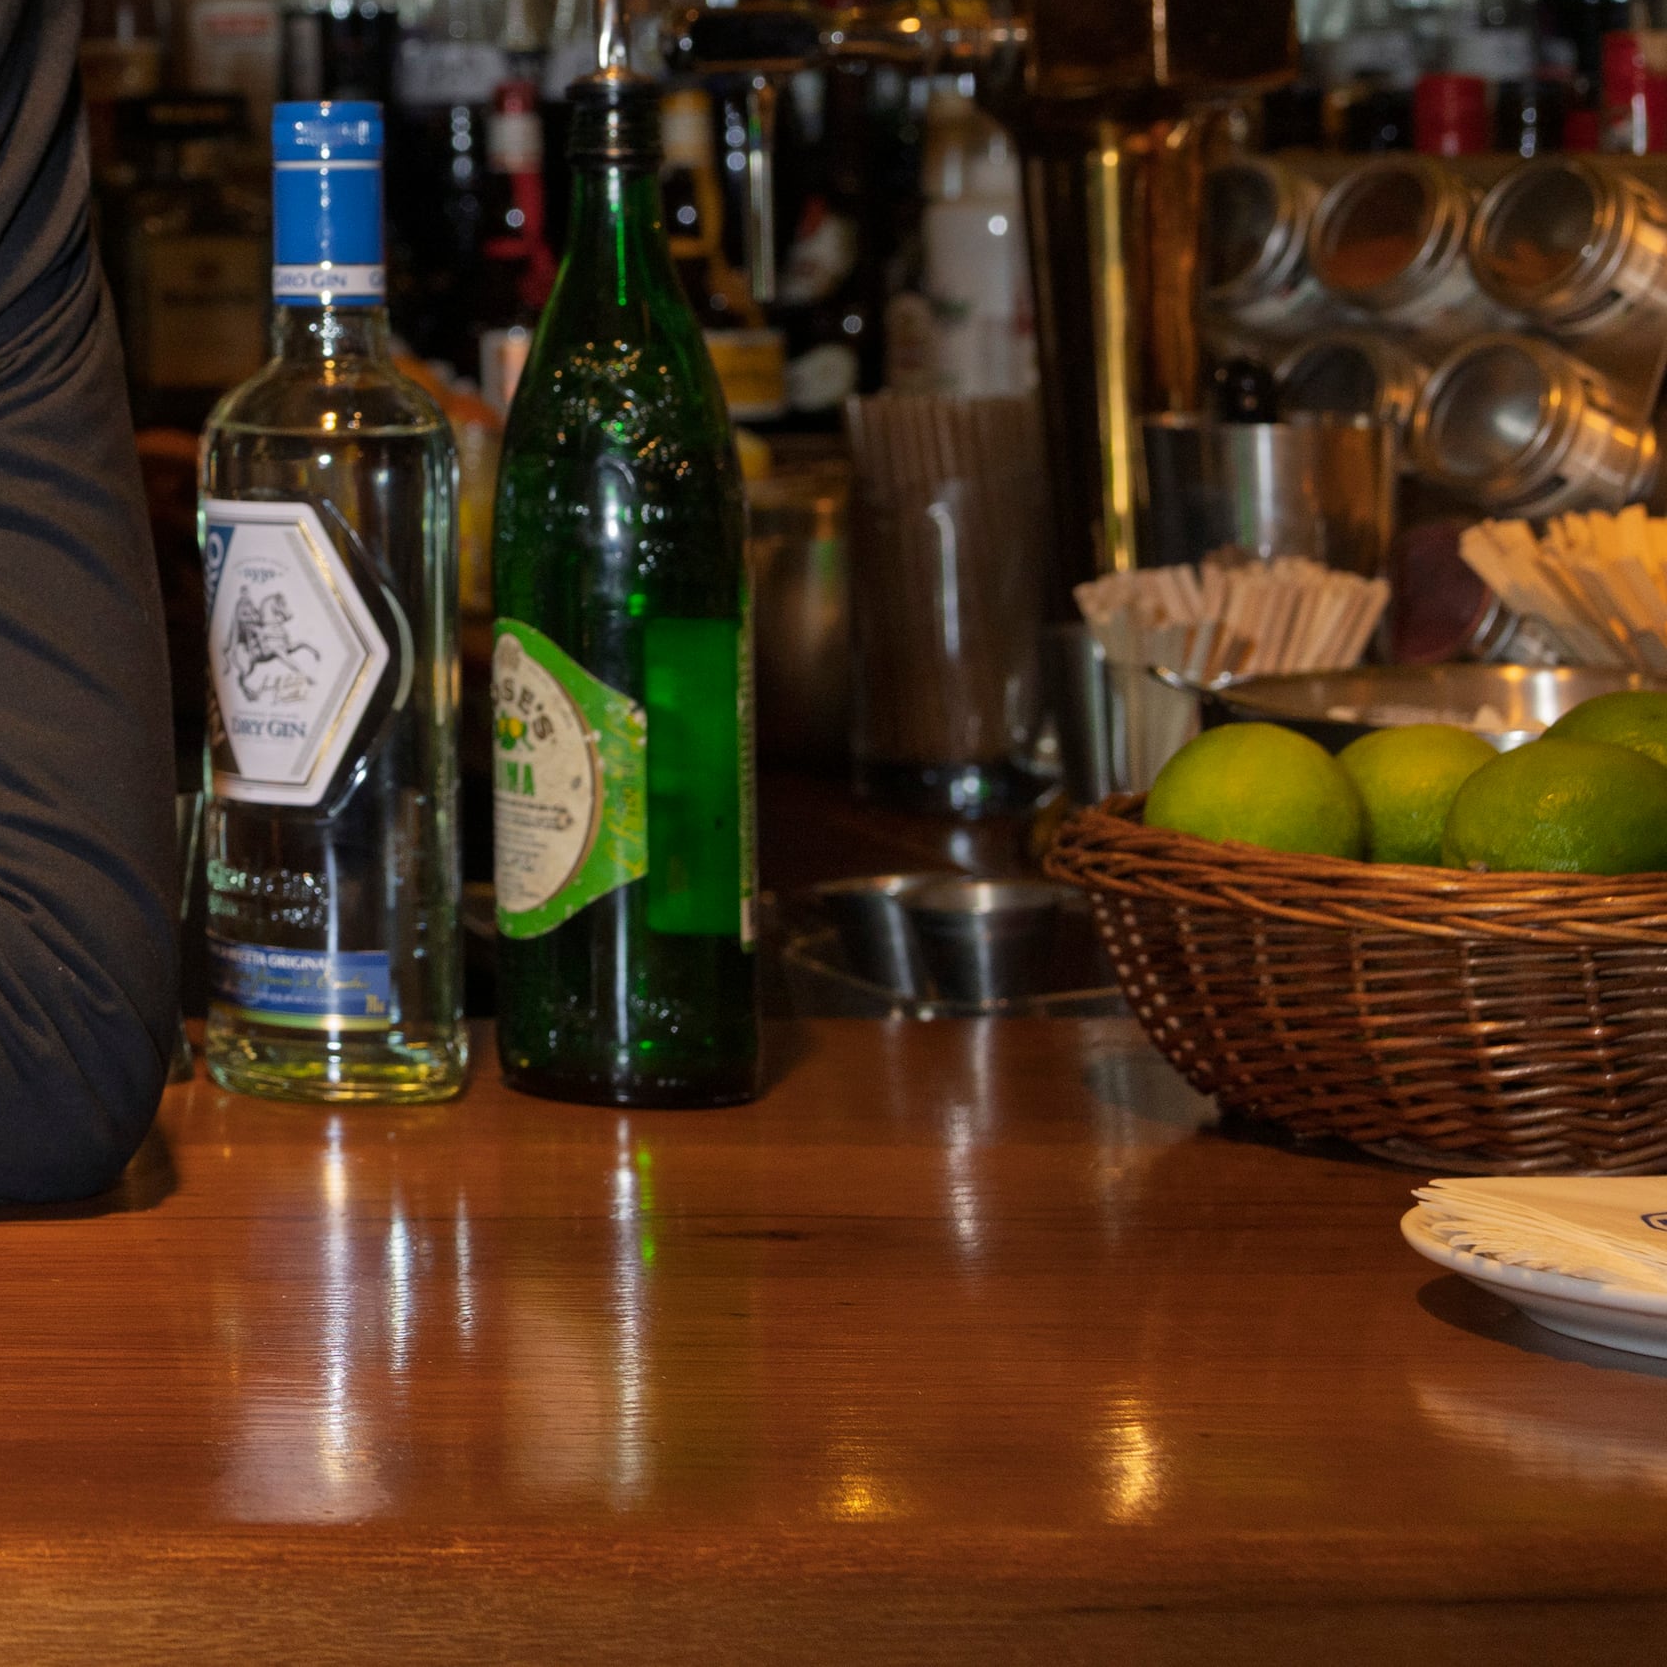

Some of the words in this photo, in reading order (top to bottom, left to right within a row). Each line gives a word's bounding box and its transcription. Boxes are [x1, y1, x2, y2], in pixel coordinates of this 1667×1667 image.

[310, 270, 348, 289] GIN
[490, 677, 556, 741] OSE'S
[230, 716, 263, 737] DRY
[267, 718, 306, 738] GIN
